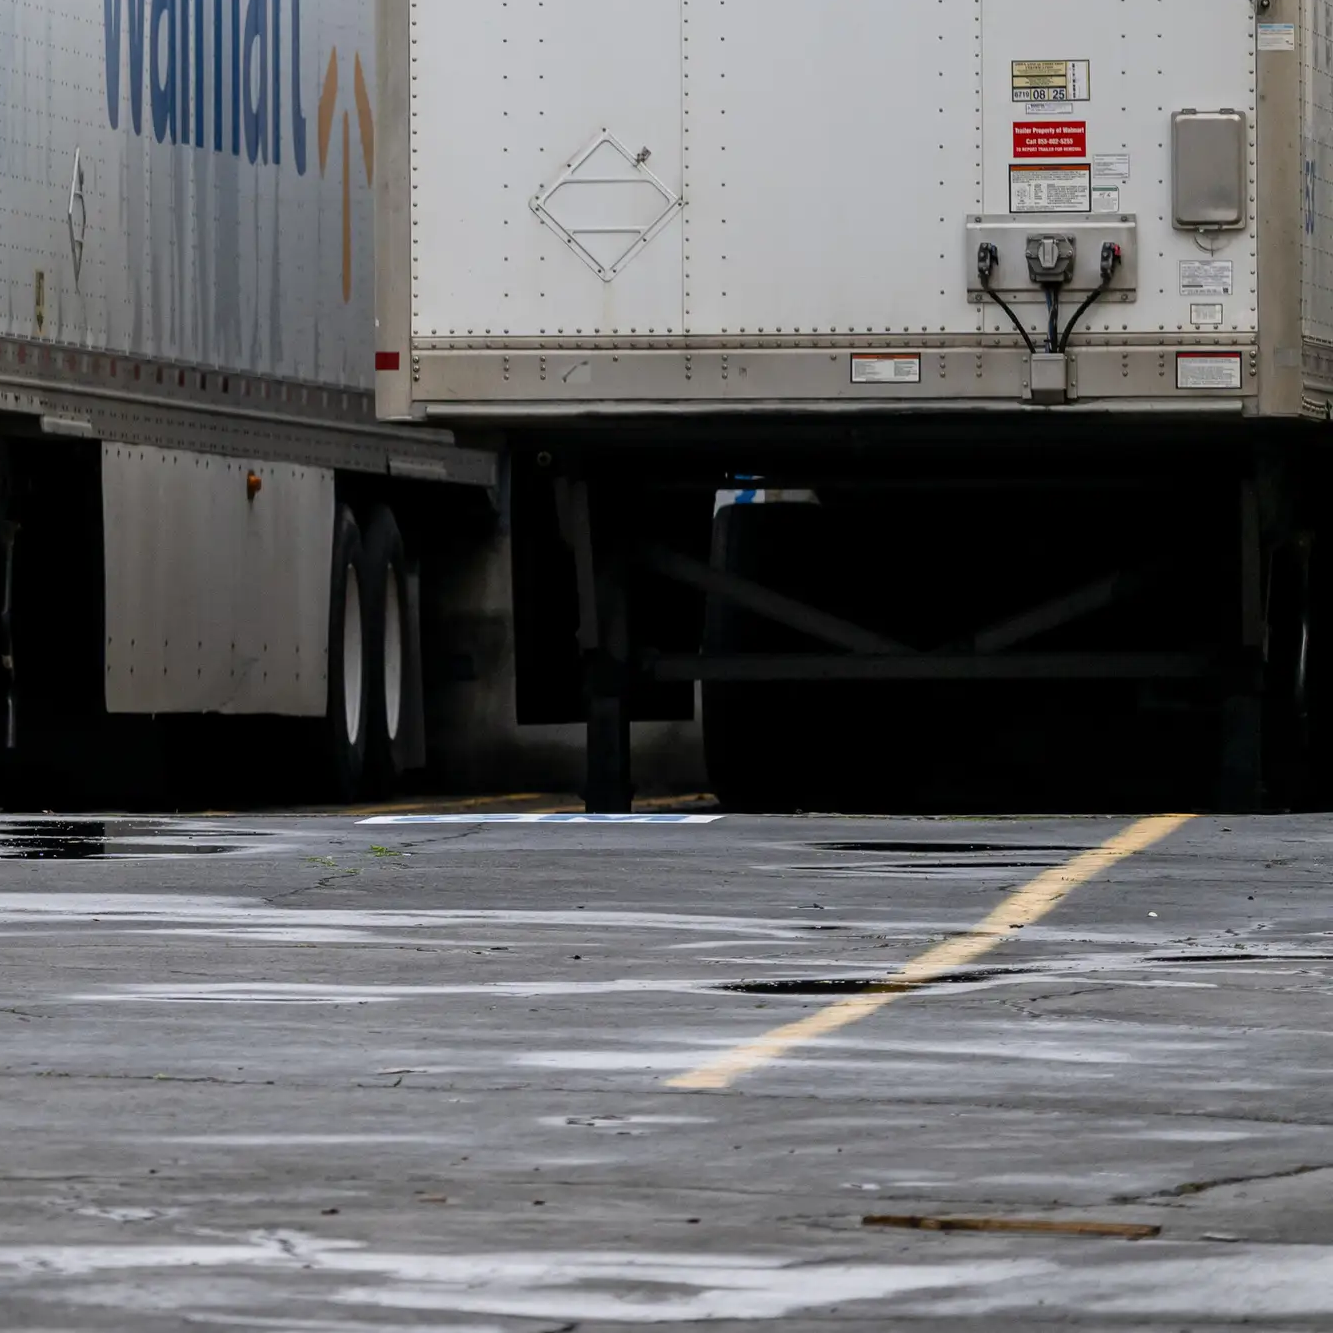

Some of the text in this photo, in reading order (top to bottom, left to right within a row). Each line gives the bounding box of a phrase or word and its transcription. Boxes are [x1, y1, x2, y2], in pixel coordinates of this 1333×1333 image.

[1033, 89, 1046, 100] 08
[1052, 89, 1065, 100] 25
[1033, 127, 1055, 135] Property
